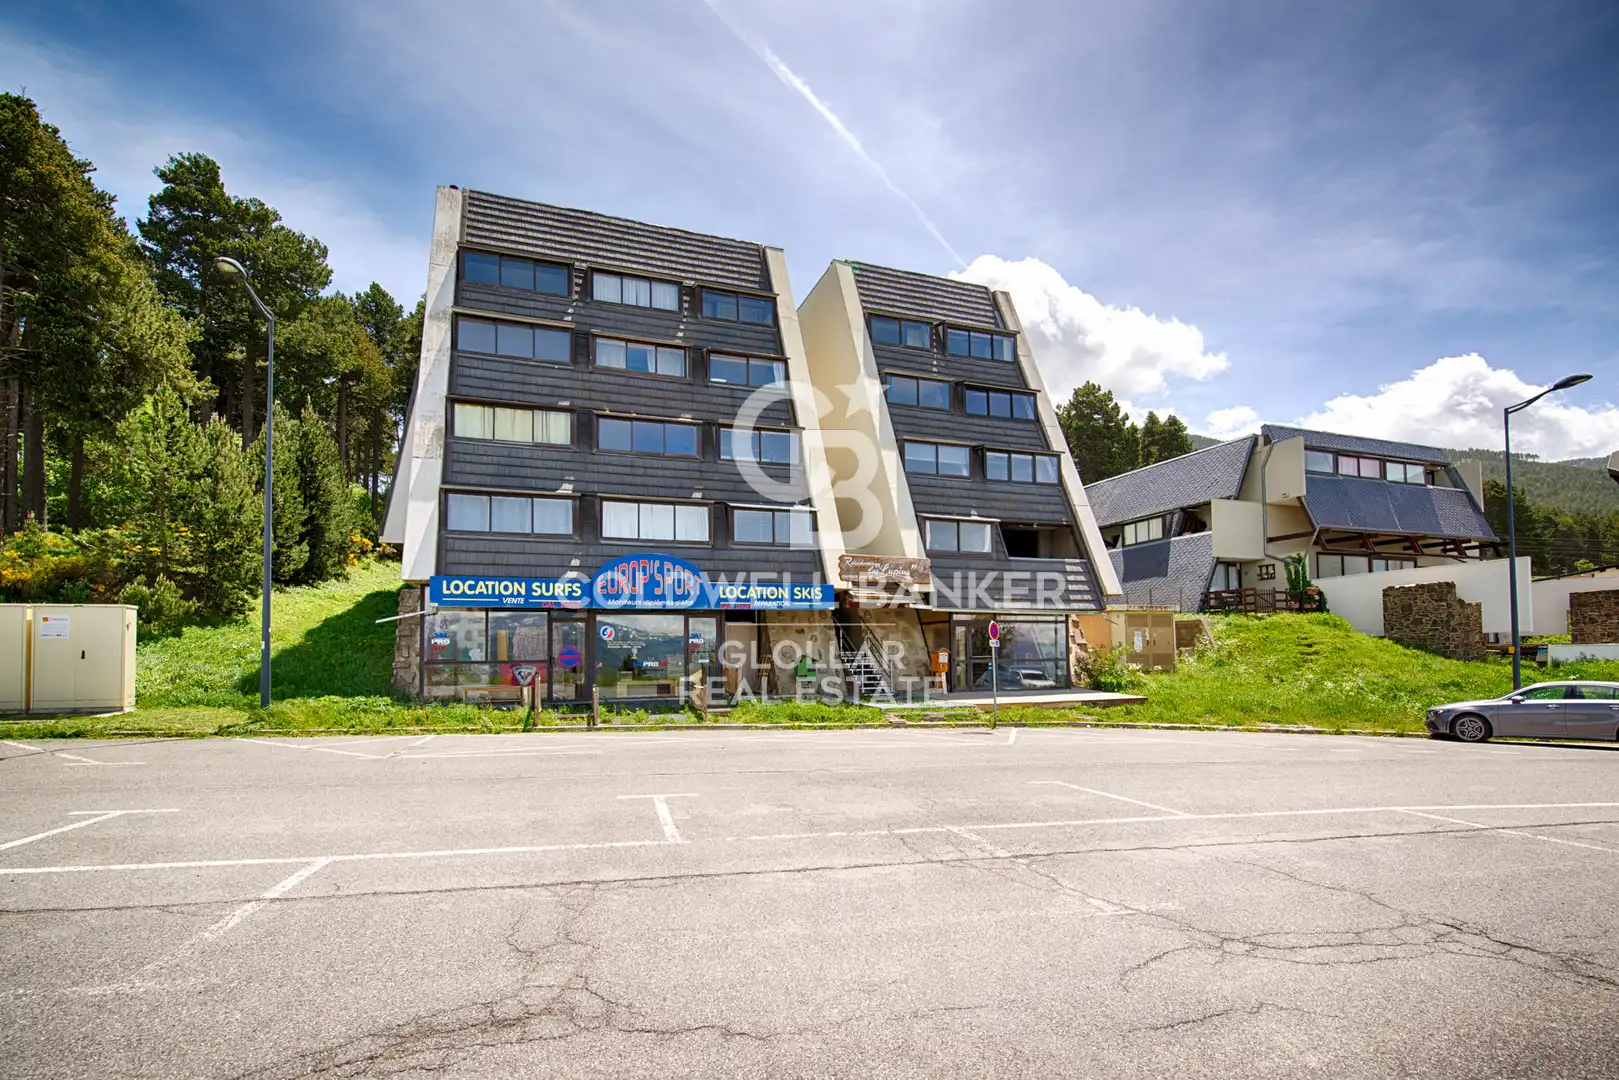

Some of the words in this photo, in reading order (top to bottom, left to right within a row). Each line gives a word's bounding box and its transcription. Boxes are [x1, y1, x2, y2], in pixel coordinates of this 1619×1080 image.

[442, 580, 526, 596] LOCATION
[531, 582, 582, 597] SURFS
[719, 586, 789, 600] LOCATION
[793, 587, 823, 600] SKIS
[502, 597, 525, 605] VENTE
